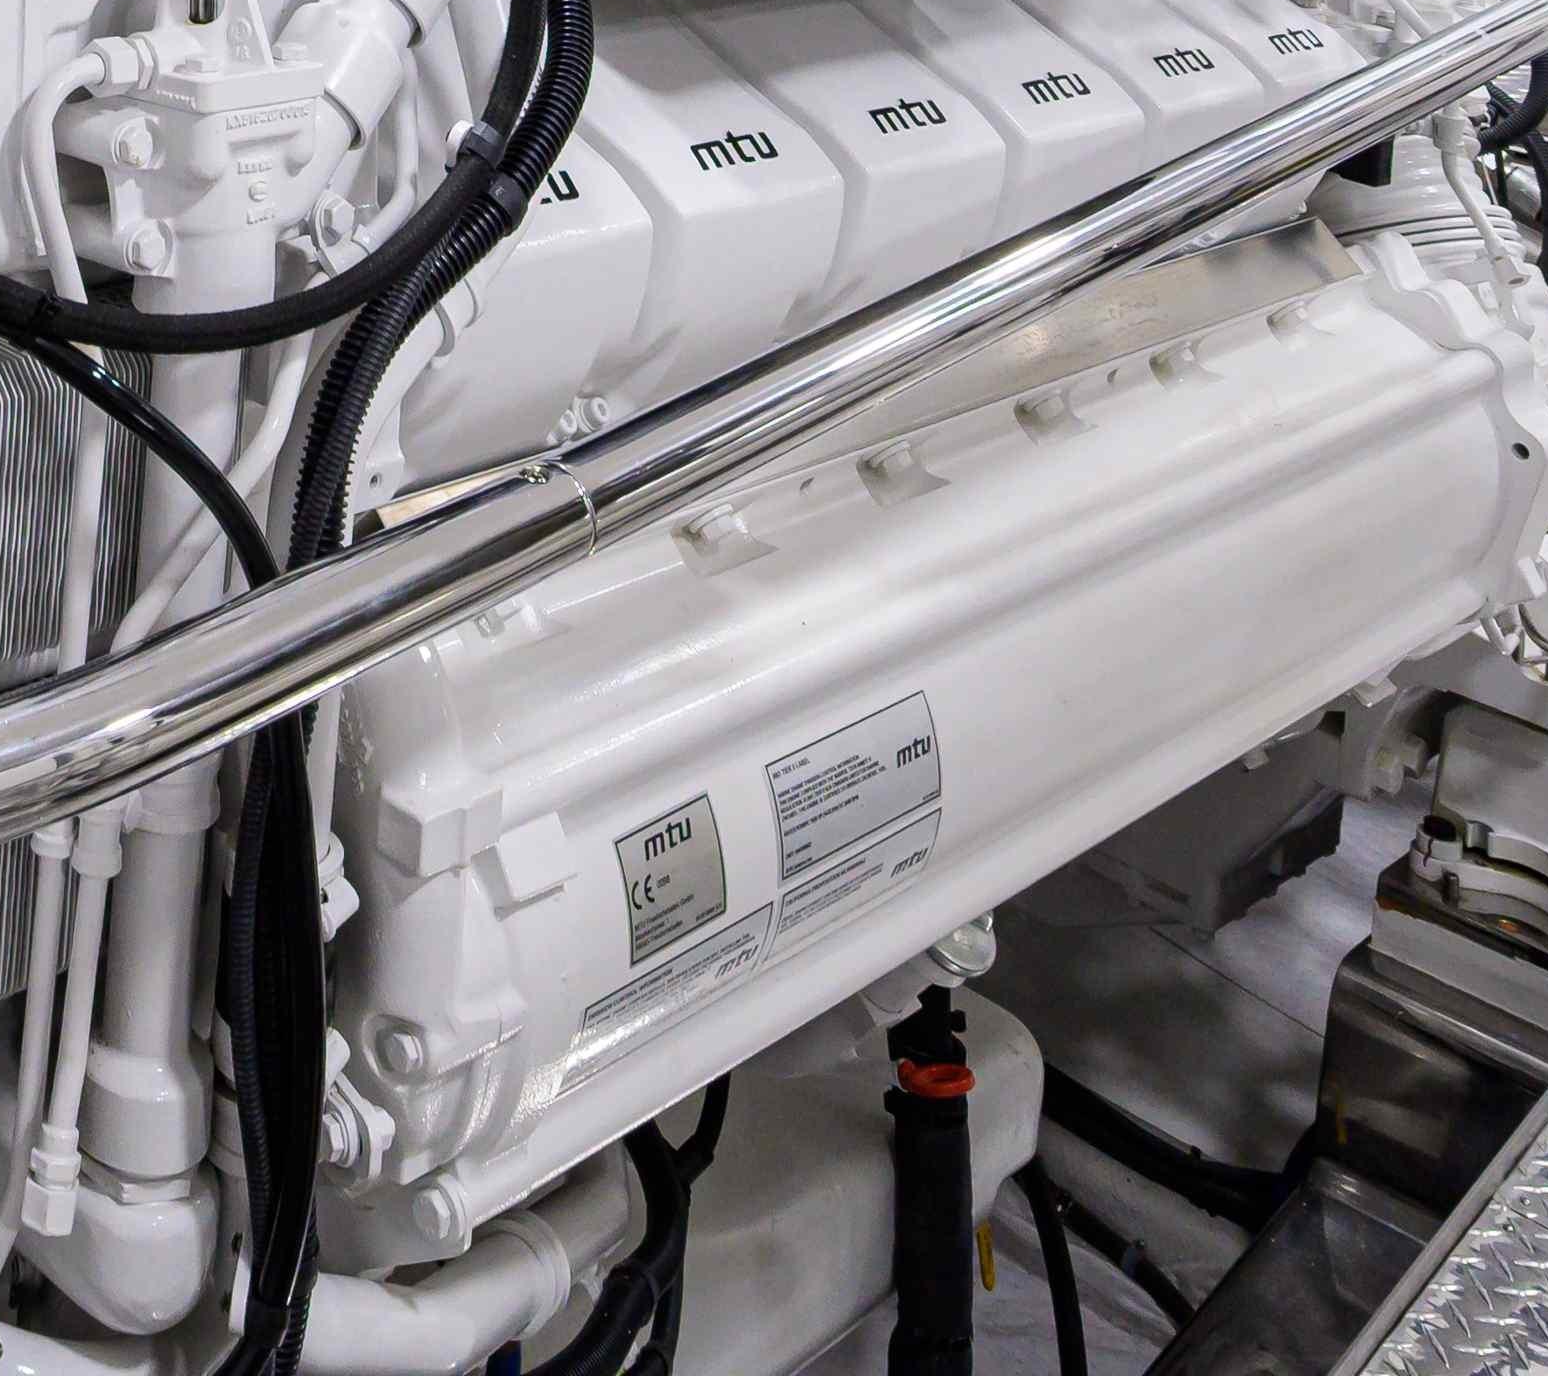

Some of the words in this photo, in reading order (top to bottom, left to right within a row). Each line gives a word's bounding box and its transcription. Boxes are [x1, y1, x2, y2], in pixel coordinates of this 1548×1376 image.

[1268, 27, 1324, 56] mtu
[1152, 45, 1216, 79] mtu
[1021, 70, 1092, 105] mtu
[868, 96, 947, 135] mtu
[690, 127, 779, 172] mtu
[896, 735, 931, 769] mtu
[644, 817, 692, 862] mtu
[890, 846, 929, 878] mtu
